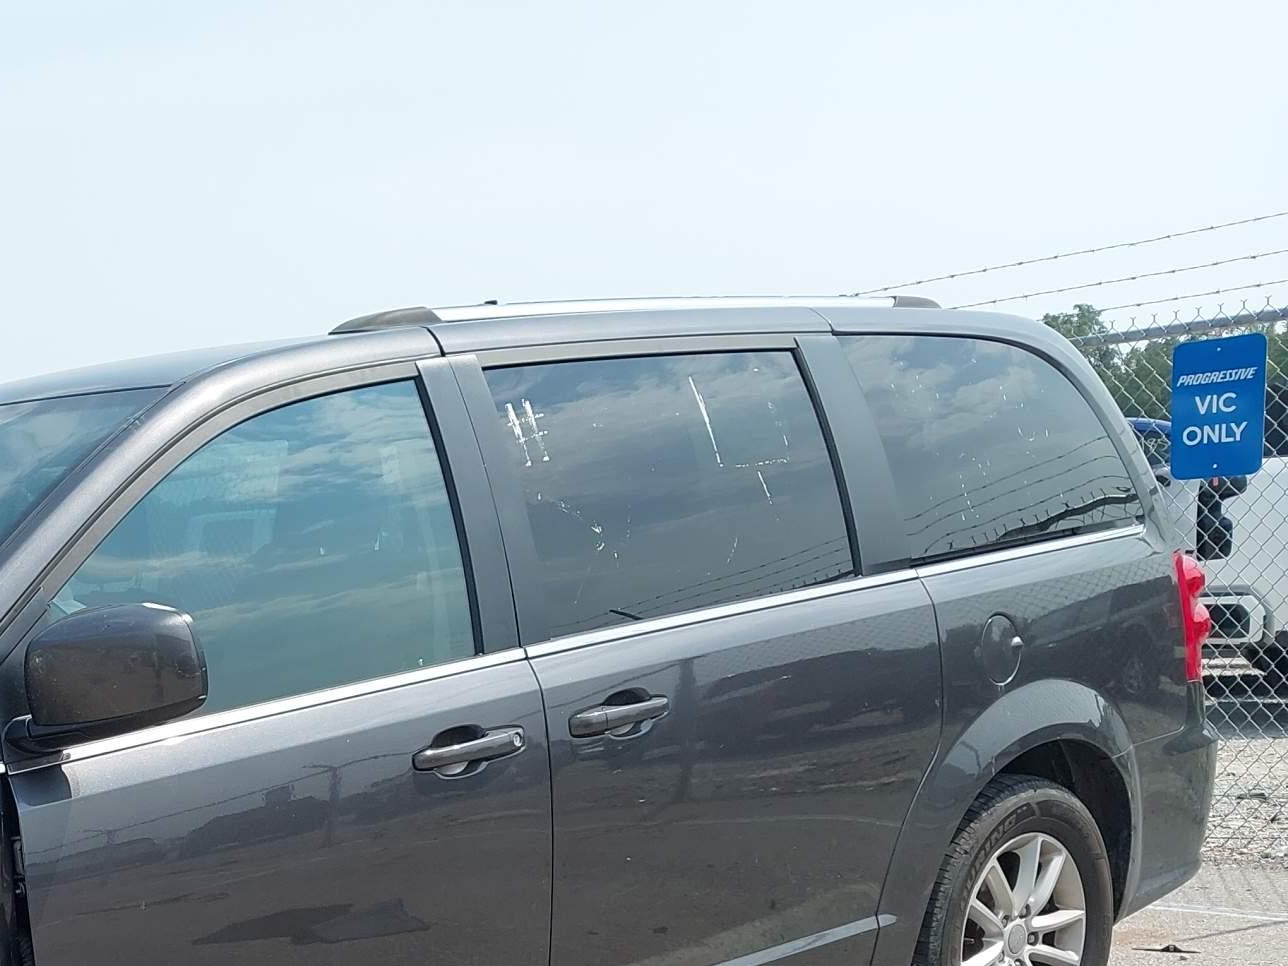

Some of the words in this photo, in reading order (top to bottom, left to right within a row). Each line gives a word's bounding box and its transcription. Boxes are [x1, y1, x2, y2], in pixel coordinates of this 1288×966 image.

[1176, 366, 1258, 387] PROGRESSIVE
[1194, 392, 1237, 415] VIC
[1182, 421, 1248, 446] ONLY
